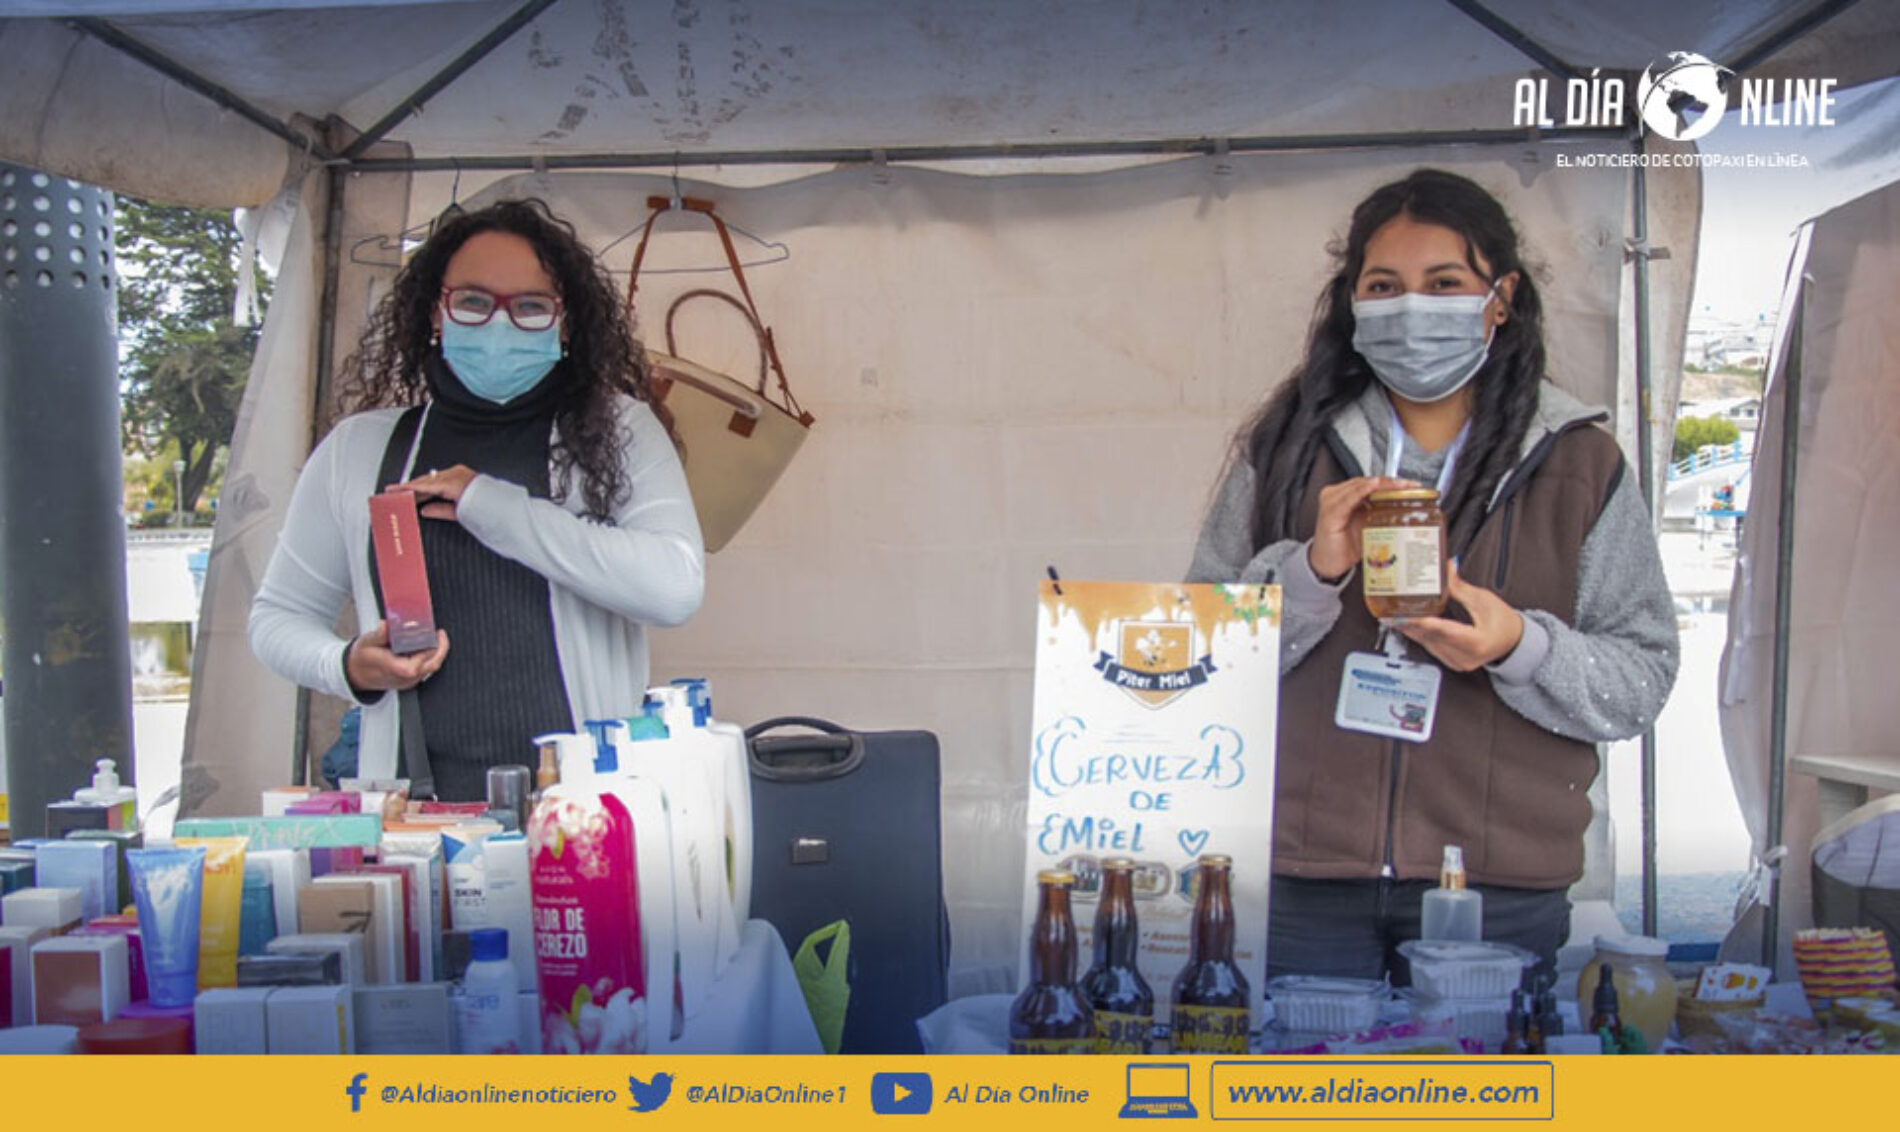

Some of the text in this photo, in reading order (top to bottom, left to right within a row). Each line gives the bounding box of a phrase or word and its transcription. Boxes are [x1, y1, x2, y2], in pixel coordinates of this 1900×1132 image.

[1117, 669, 1193, 689] Piter Miel
[1128, 790, 1172, 811] DE
[453, 887, 483, 898] SKIN
[564, 907, 586, 931] DE
[536, 932, 588, 958] CEREZO
